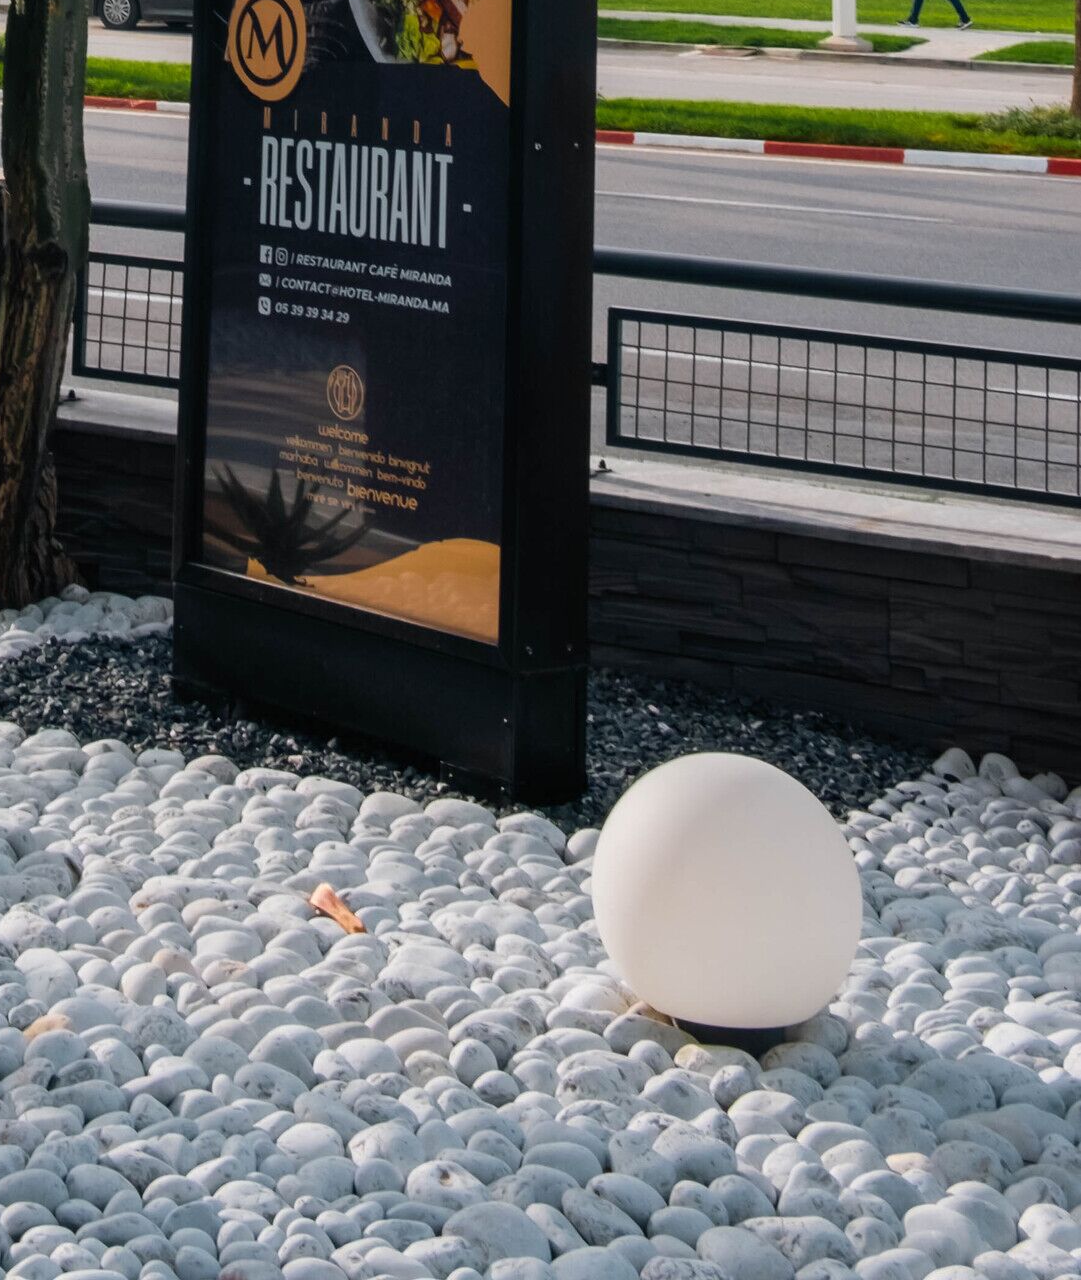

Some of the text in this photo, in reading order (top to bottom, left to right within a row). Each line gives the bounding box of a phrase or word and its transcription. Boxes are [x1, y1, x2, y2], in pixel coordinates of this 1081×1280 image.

[263, 106, 452, 148] MIRANDA
[259, 135, 453, 249] RESTAURANT
[296, 254, 367, 274] RESTAURANT
[400, 268, 452, 287] MIRANDA
[281, 277, 450, 313] CONTACT@HOTEL-MIRANDA.MA
[275, 302, 350, 324] 05 39 39 34 29
[317, 424, 369, 445] welcome
[279, 449, 318, 466] marhaba
[347, 478, 418, 511] bienvenue
